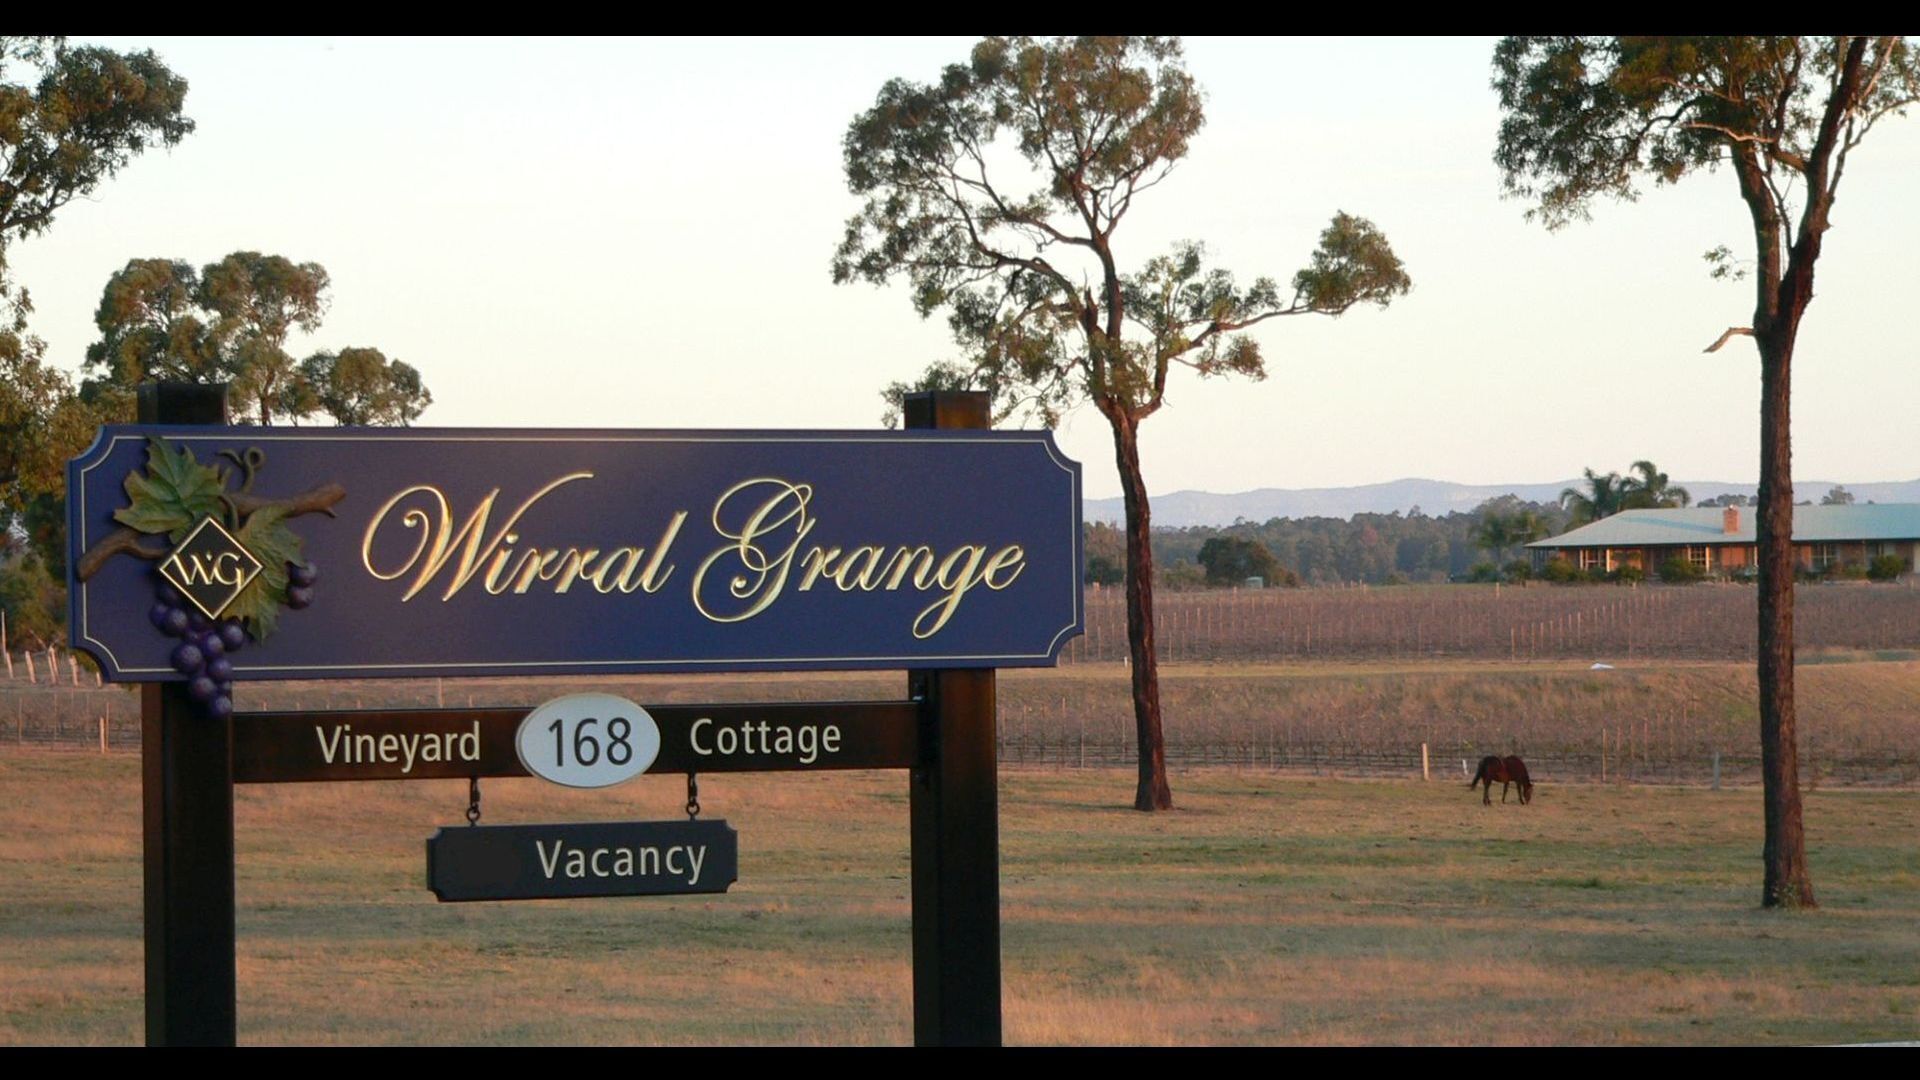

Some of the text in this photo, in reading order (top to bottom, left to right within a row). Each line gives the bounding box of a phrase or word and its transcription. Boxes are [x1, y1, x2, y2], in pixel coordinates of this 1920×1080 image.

[362, 472, 1026, 639] Wirral Grange
[315, 720, 481, 773] Vineyard
[548, 716, 634, 767] 168
[689, 717, 842, 765] Cottage
[535, 839, 707, 886] Vacancy
